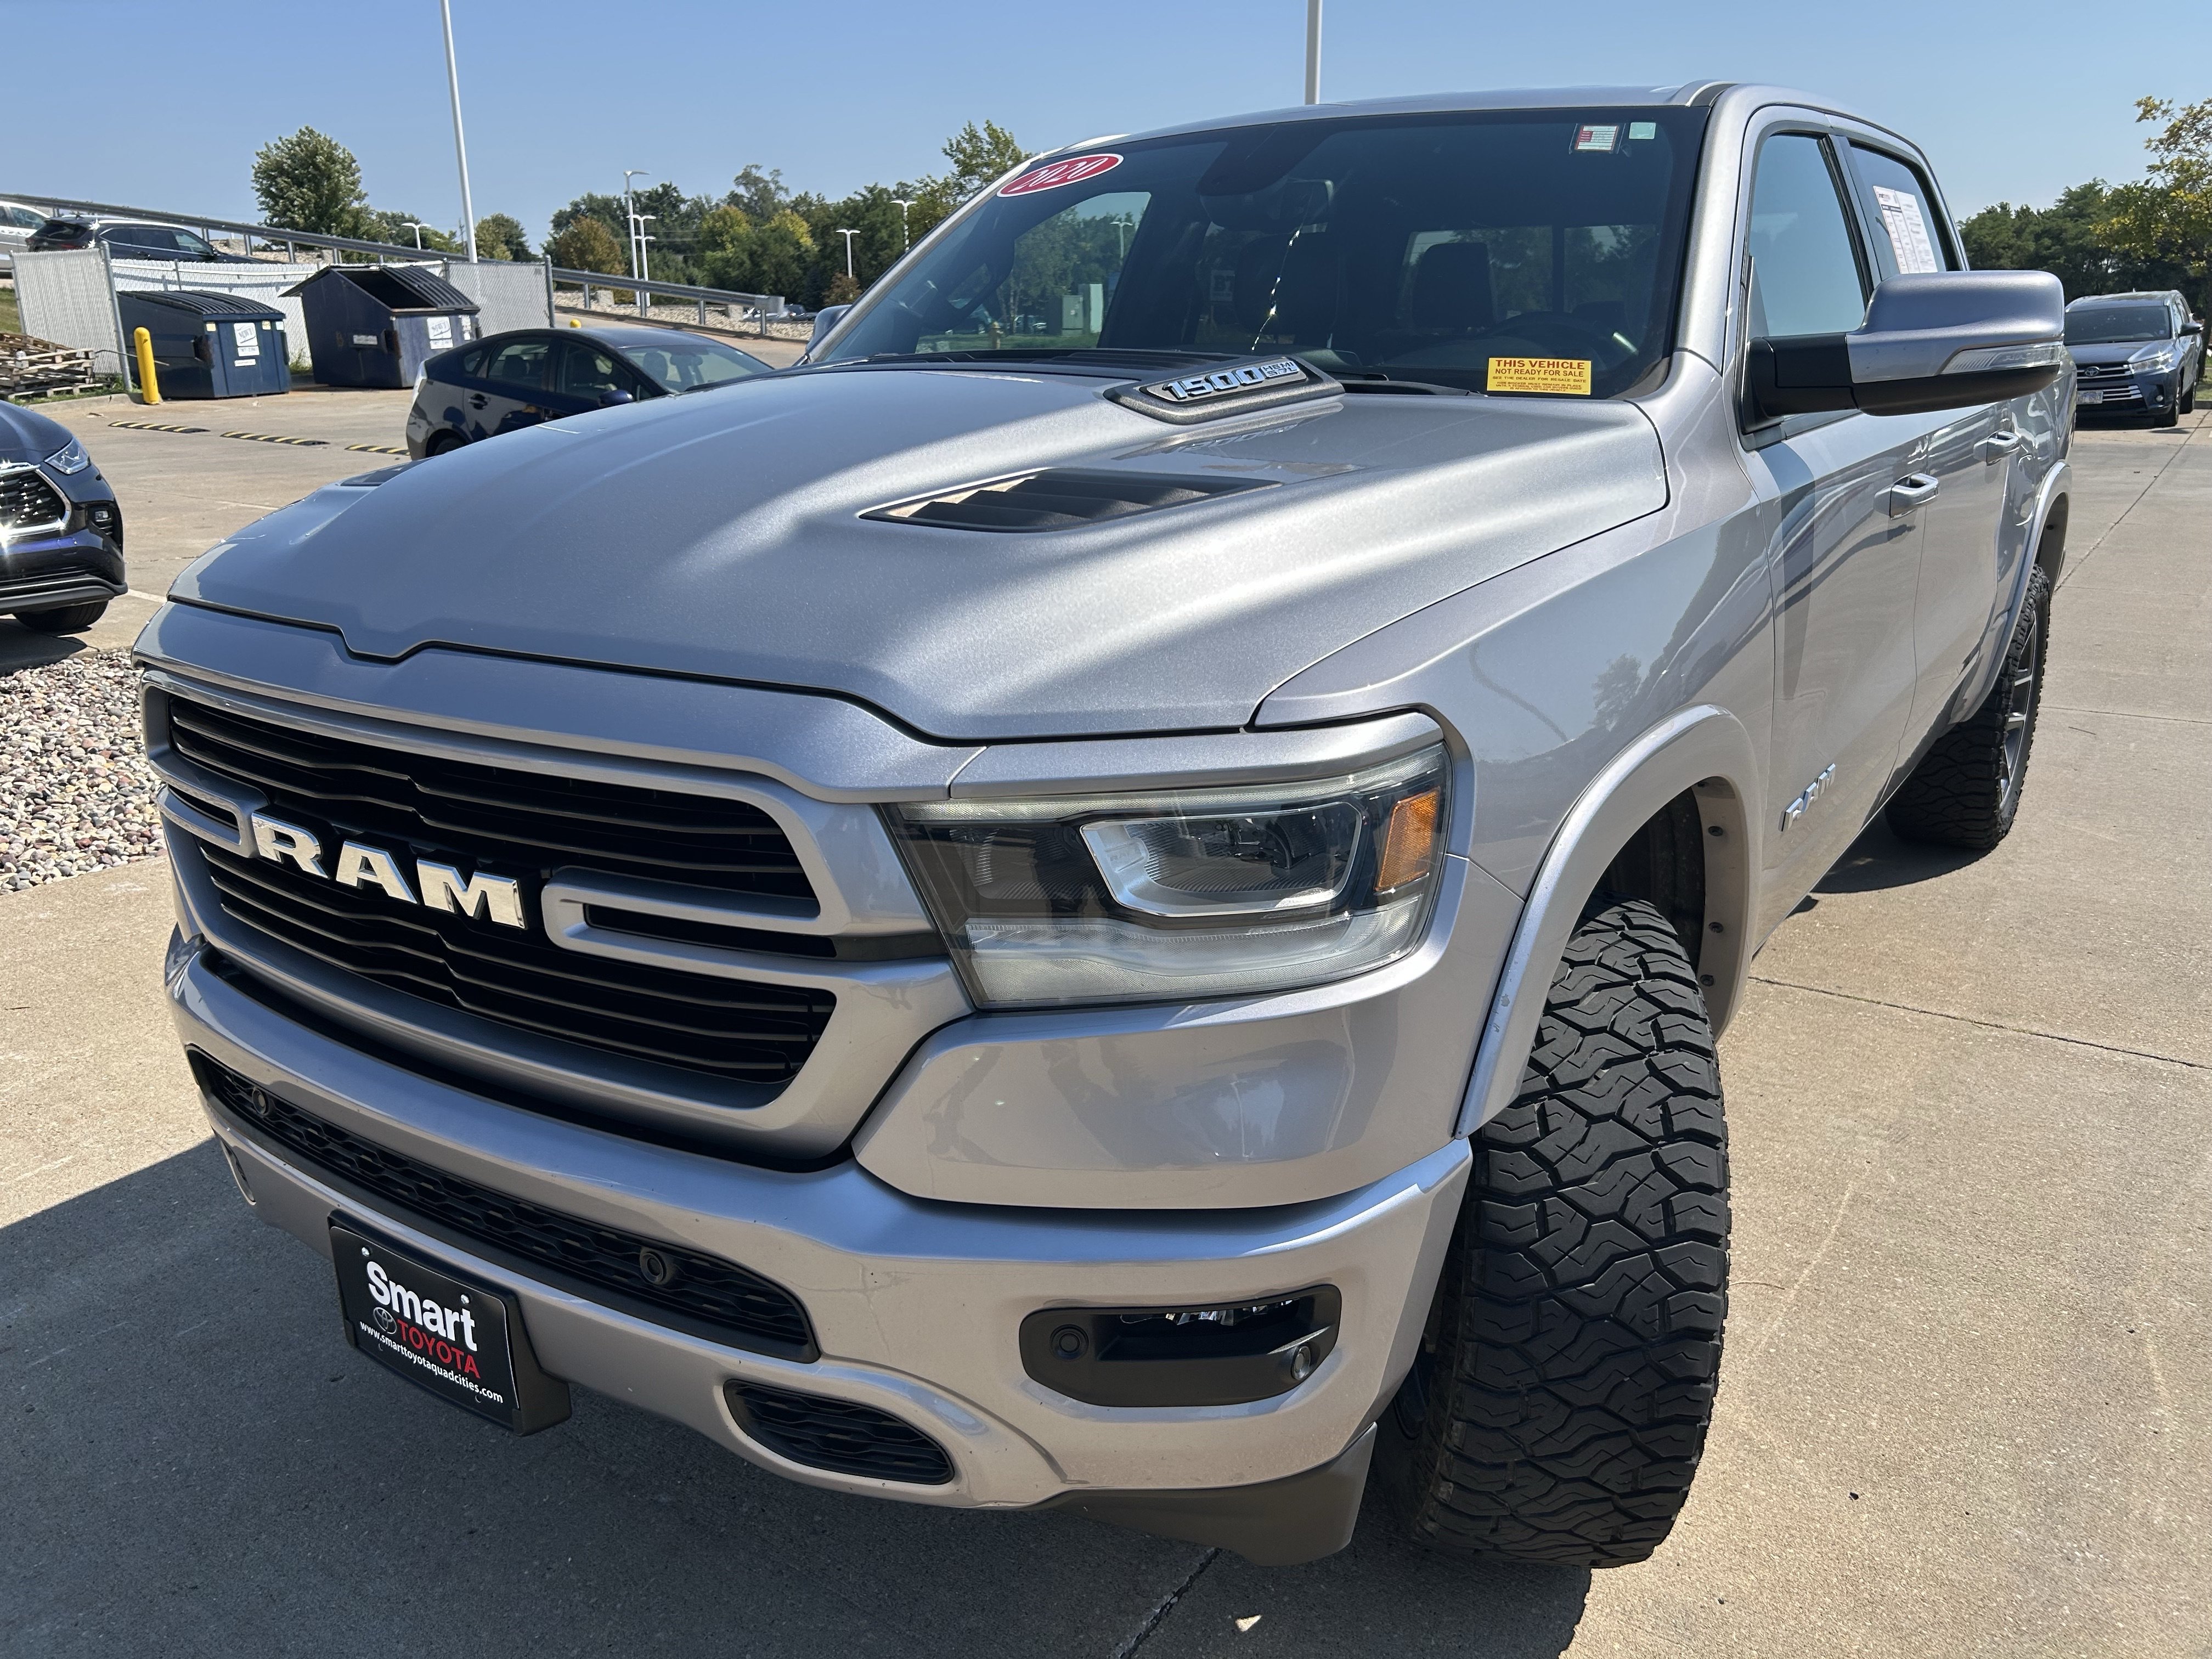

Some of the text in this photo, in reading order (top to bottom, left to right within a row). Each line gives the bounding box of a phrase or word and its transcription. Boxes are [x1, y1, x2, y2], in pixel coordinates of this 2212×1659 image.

[1007, 157, 1109, 193] 2020
[1165, 367, 1265, 400] 1500
[1262, 362, 1294, 371] HEMI
[1496, 359, 1585, 370] THIS VEHICLE
[251, 811, 527, 929] RAM
[366, 1261, 478, 1352] Smart
[359, 1321, 504, 1404] www.smarttoyotaquadcities.com
[397, 1319, 481, 1379] TOYOTA
